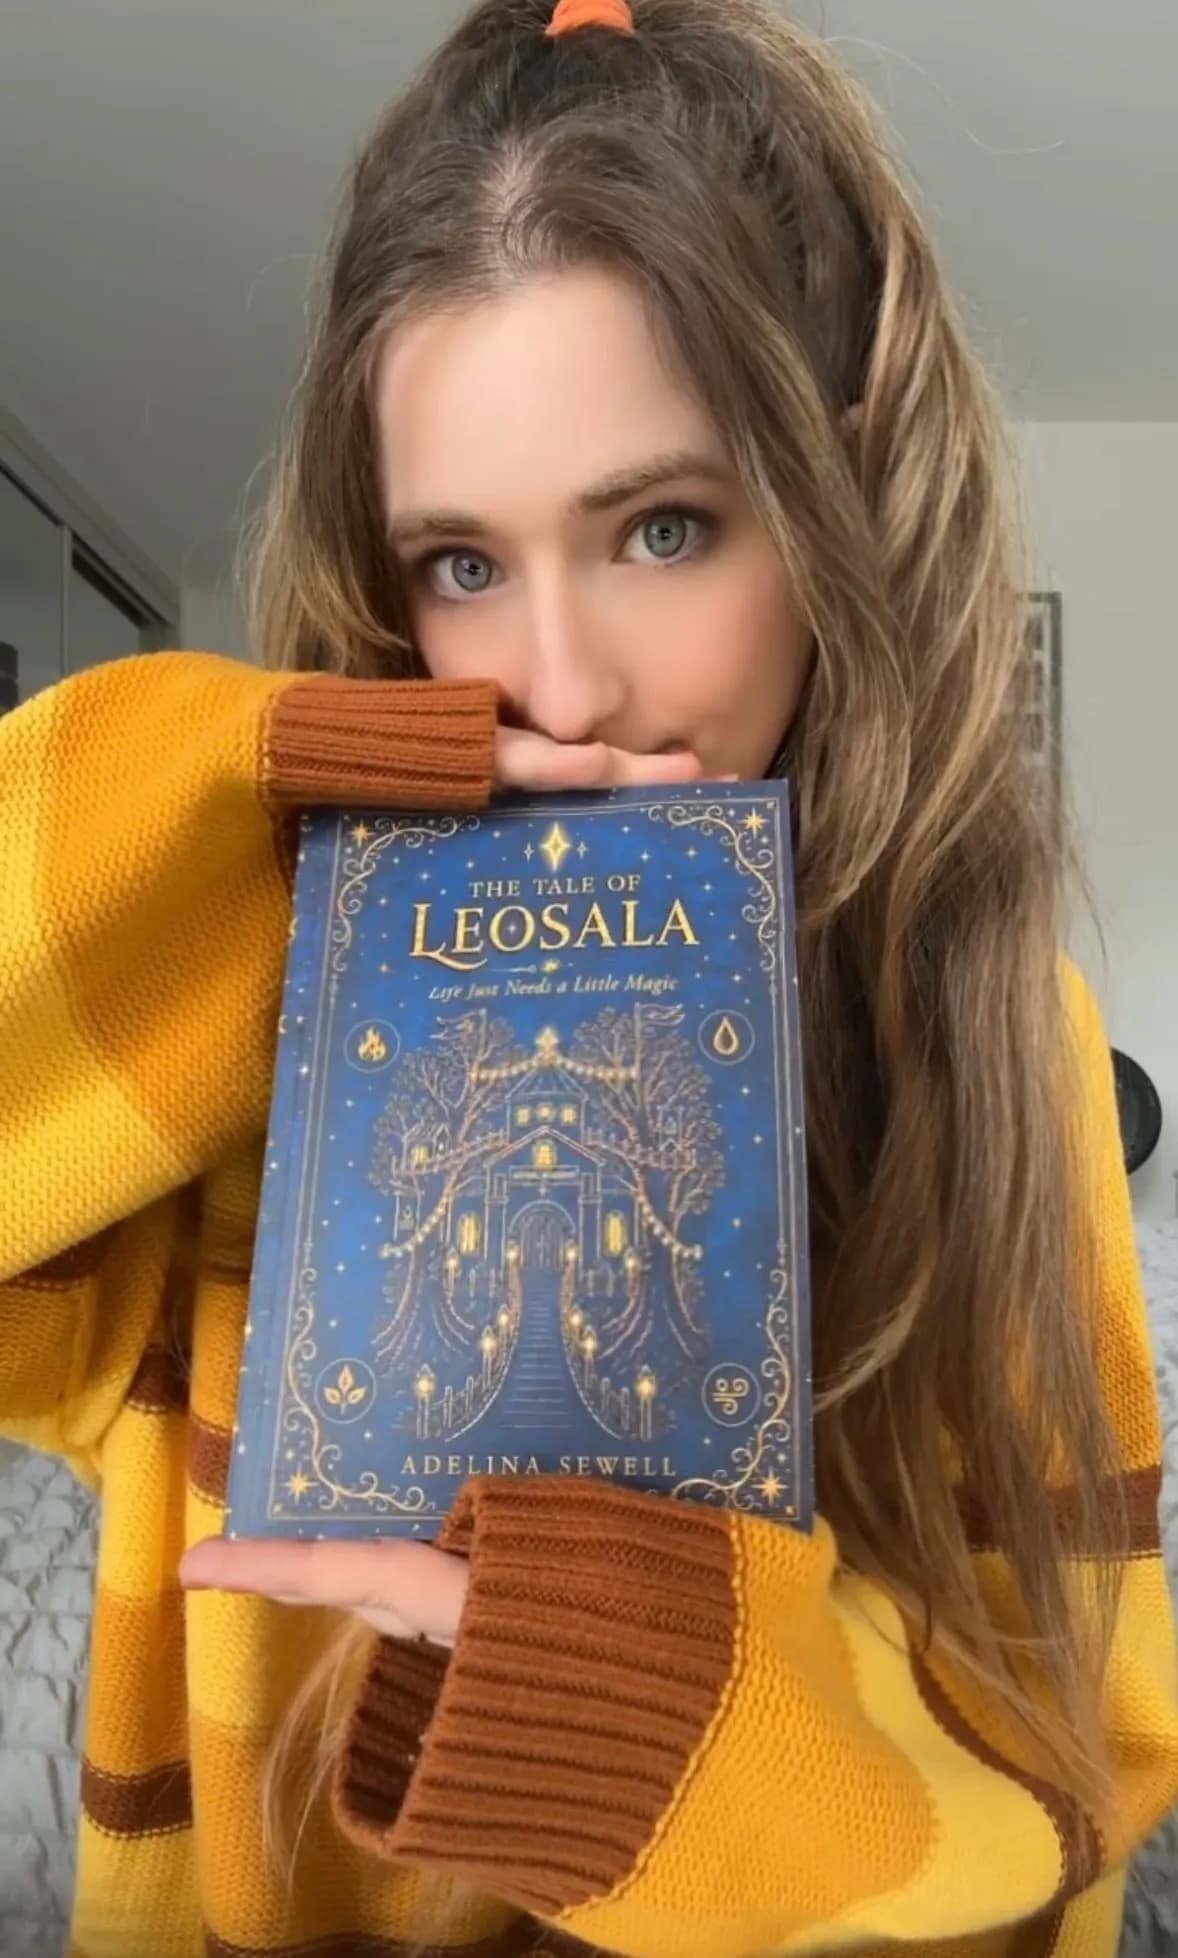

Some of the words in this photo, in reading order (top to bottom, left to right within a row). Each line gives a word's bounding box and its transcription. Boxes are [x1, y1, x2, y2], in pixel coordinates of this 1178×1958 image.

[469, 879, 521, 898] THE
[533, 876, 594, 895] TALE
[607, 874, 641, 892] OF
[409, 898, 700, 971] LEOSALA
[428, 985, 462, 1000] Life
[464, 983, 498, 1000] Just
[504, 979, 551, 996] Needs
[556, 982, 567, 994] a
[573, 975, 620, 993] Little
[624, 974, 678, 995] Magic
[400, 1455, 540, 1475] ADELINA
[559, 1456, 677, 1476] SEWELL
